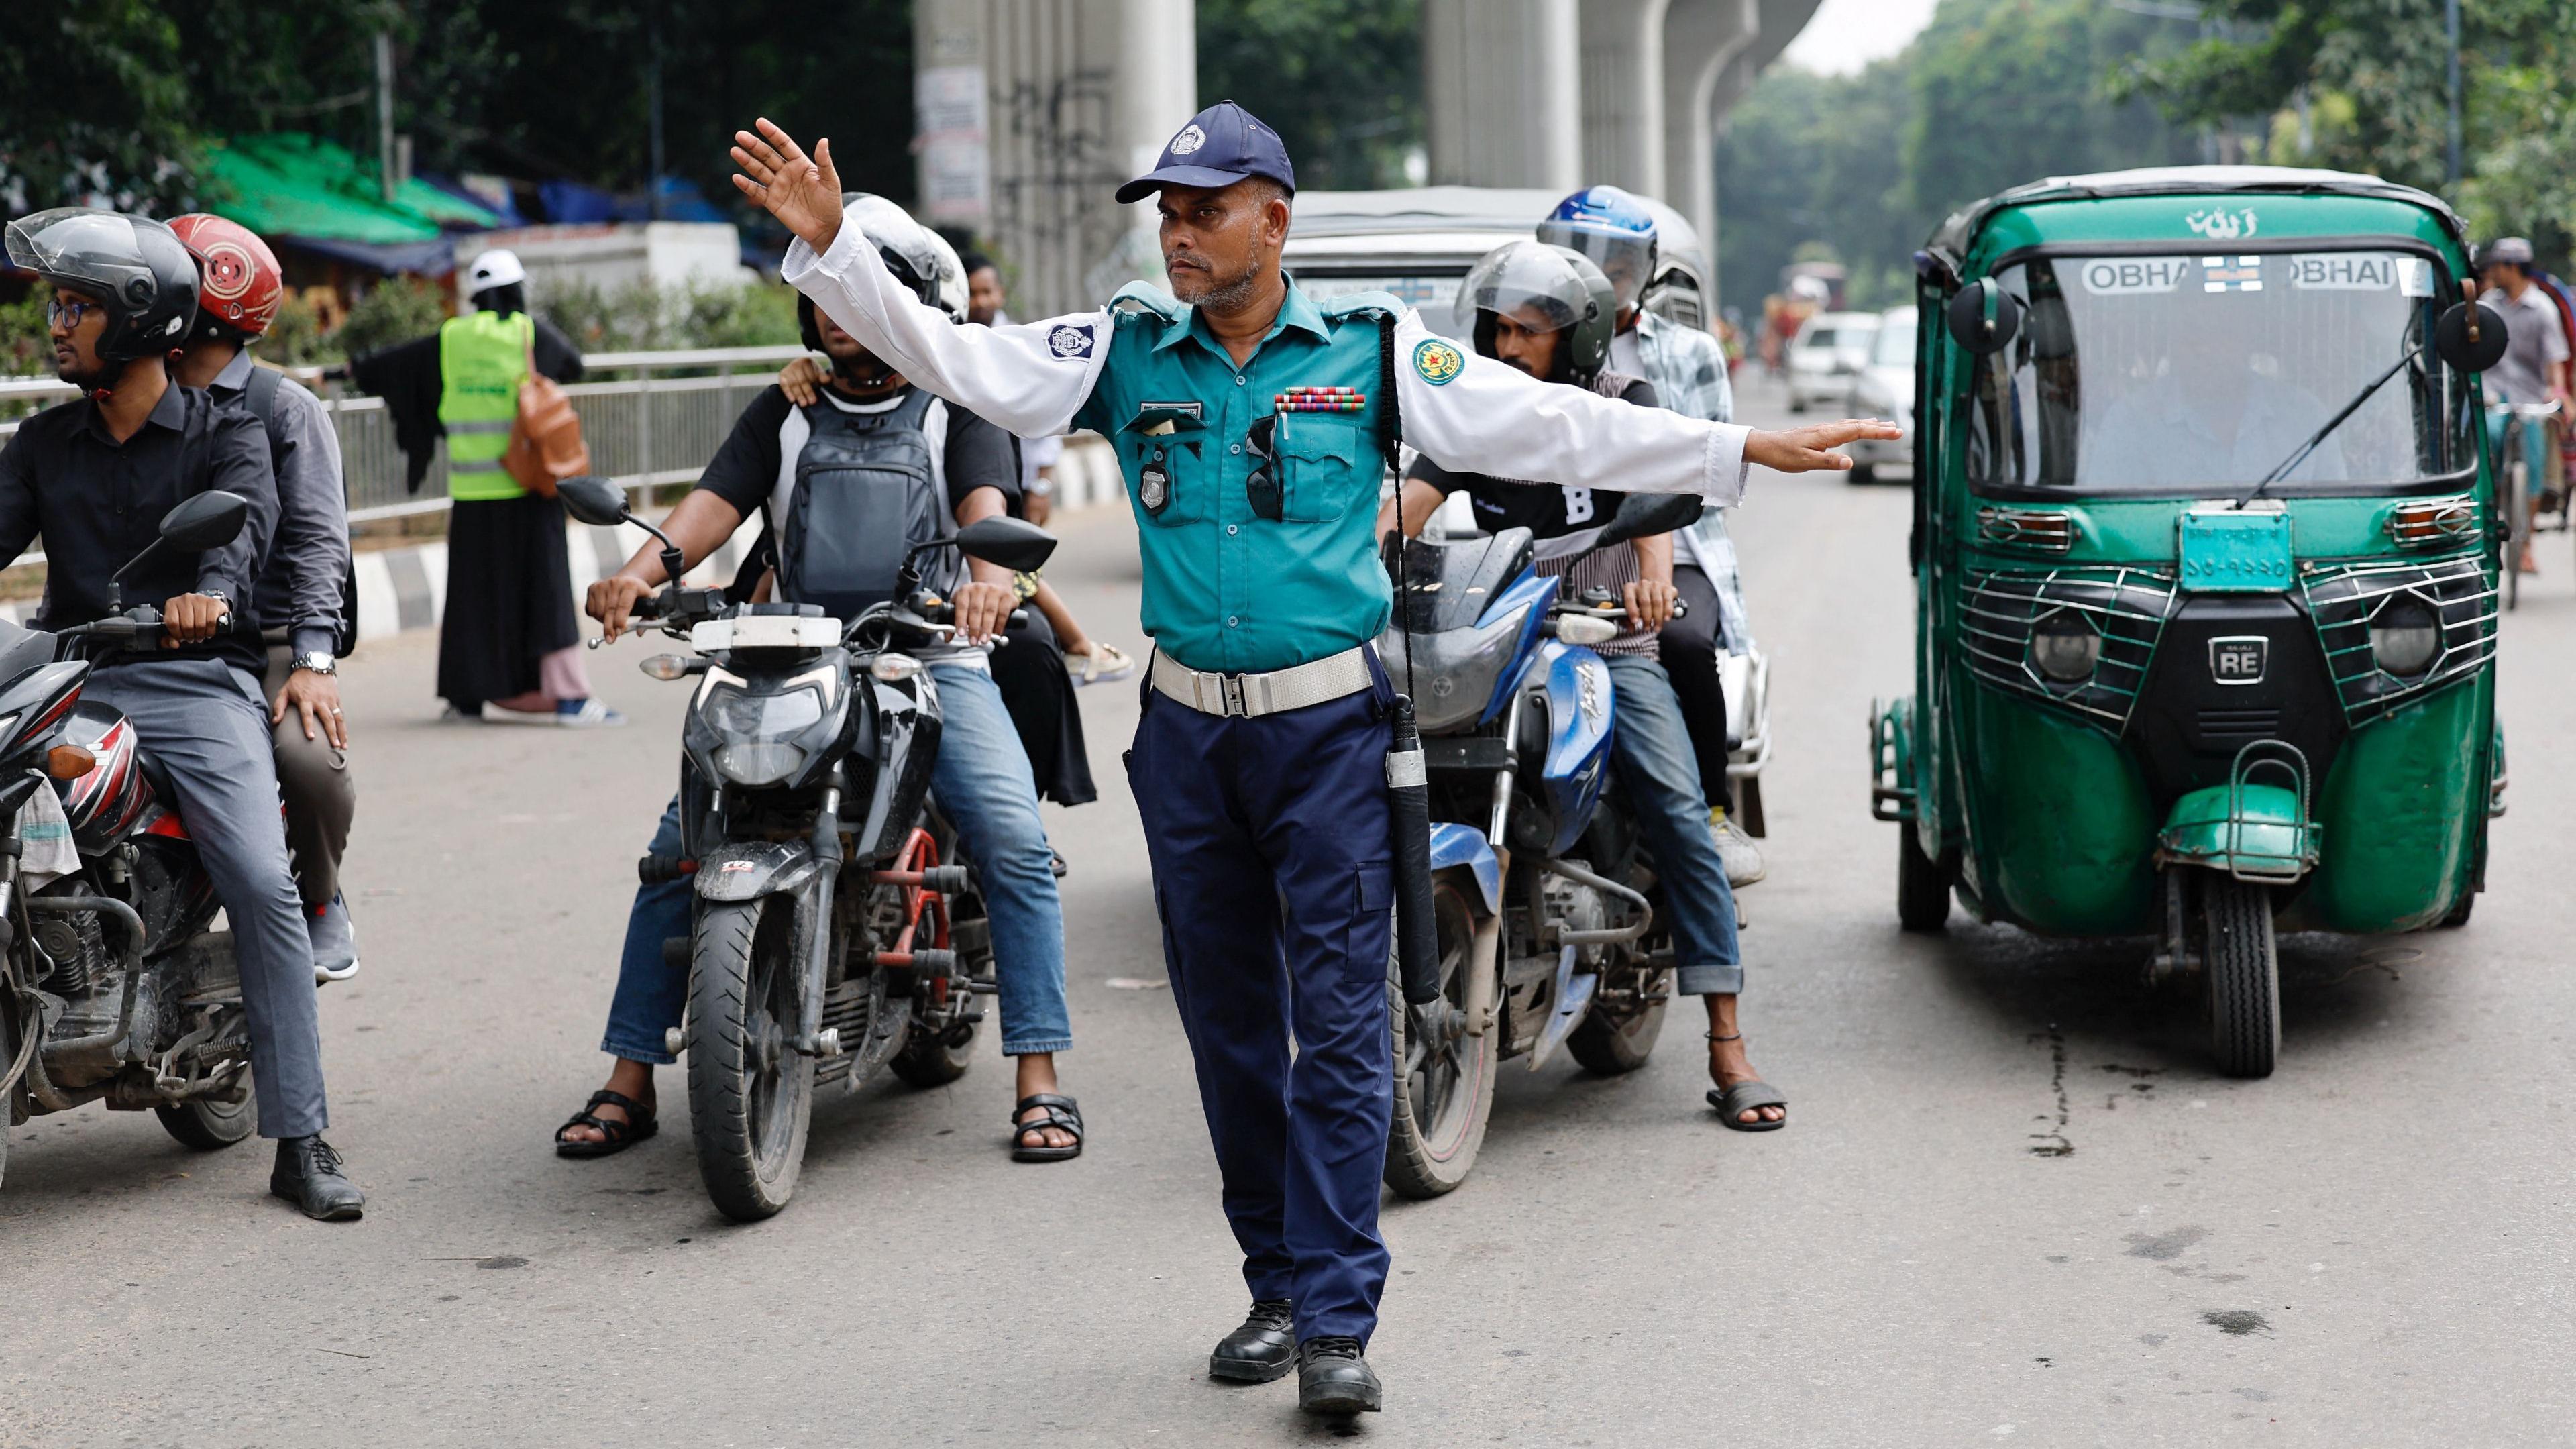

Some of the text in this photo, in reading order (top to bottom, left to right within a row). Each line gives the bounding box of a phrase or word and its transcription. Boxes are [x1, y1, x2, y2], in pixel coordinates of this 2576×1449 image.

[1562, 486, 1594, 525] B
[2220, 652, 2258, 675] RE
[722, 860, 755, 868] TVS
